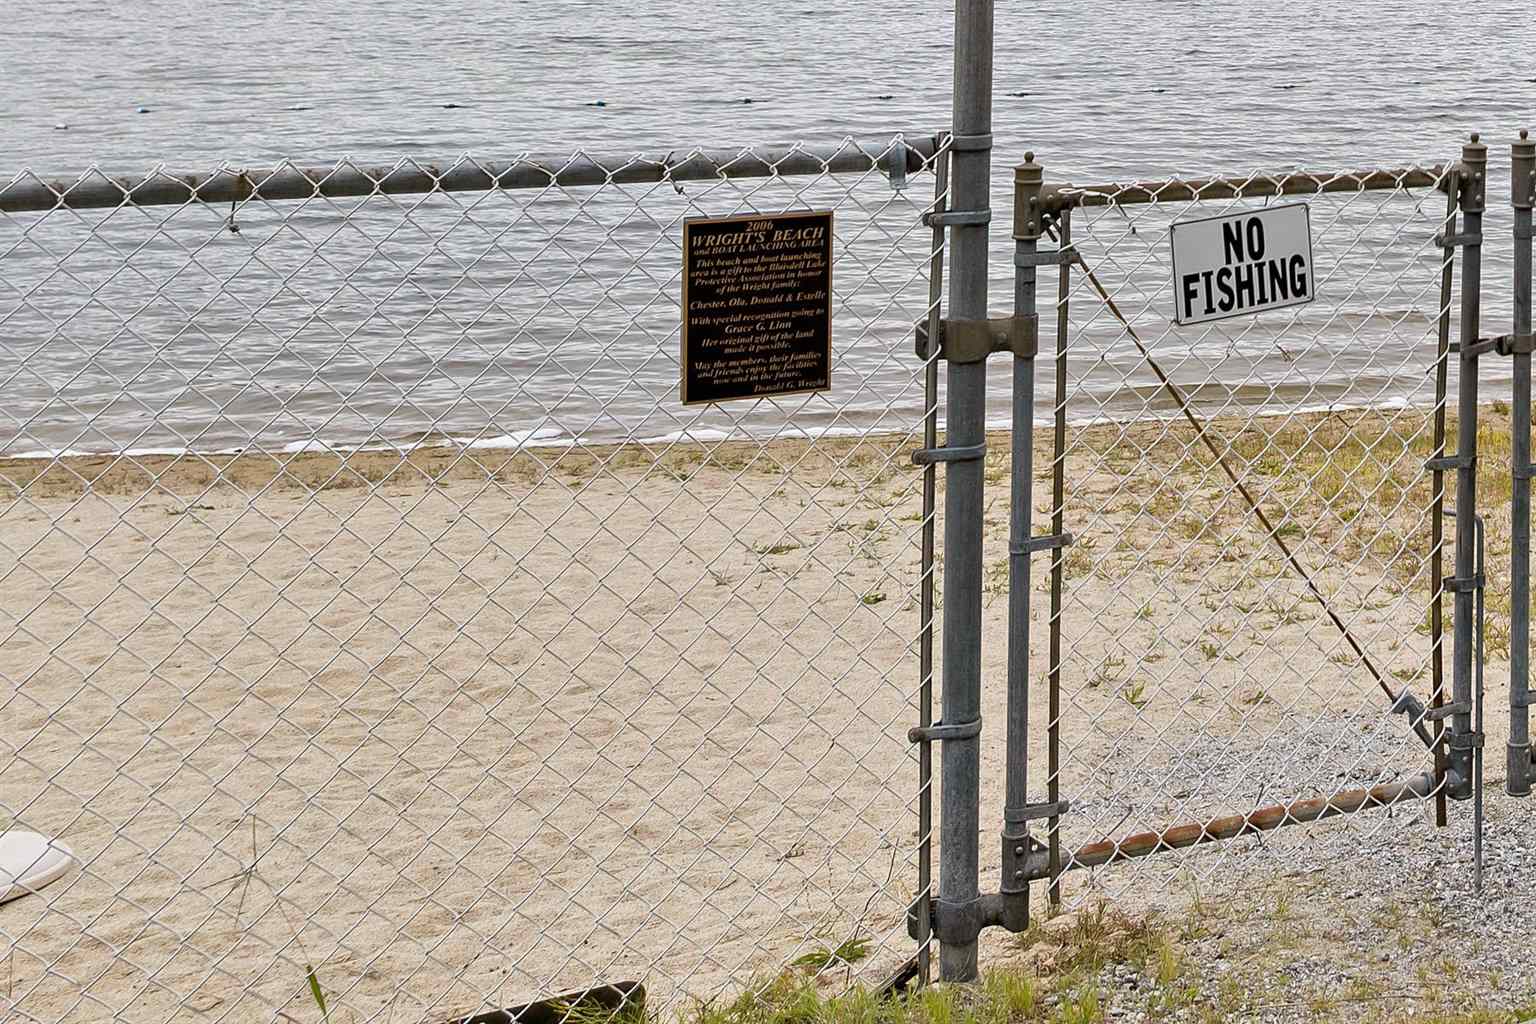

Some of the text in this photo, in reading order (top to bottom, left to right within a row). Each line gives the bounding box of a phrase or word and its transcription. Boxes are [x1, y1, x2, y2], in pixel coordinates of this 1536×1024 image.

[692, 227, 825, 246] WRIGHT'S BEACH
[1222, 217, 1265, 265] NO
[1182, 254, 1307, 318] FISHING
